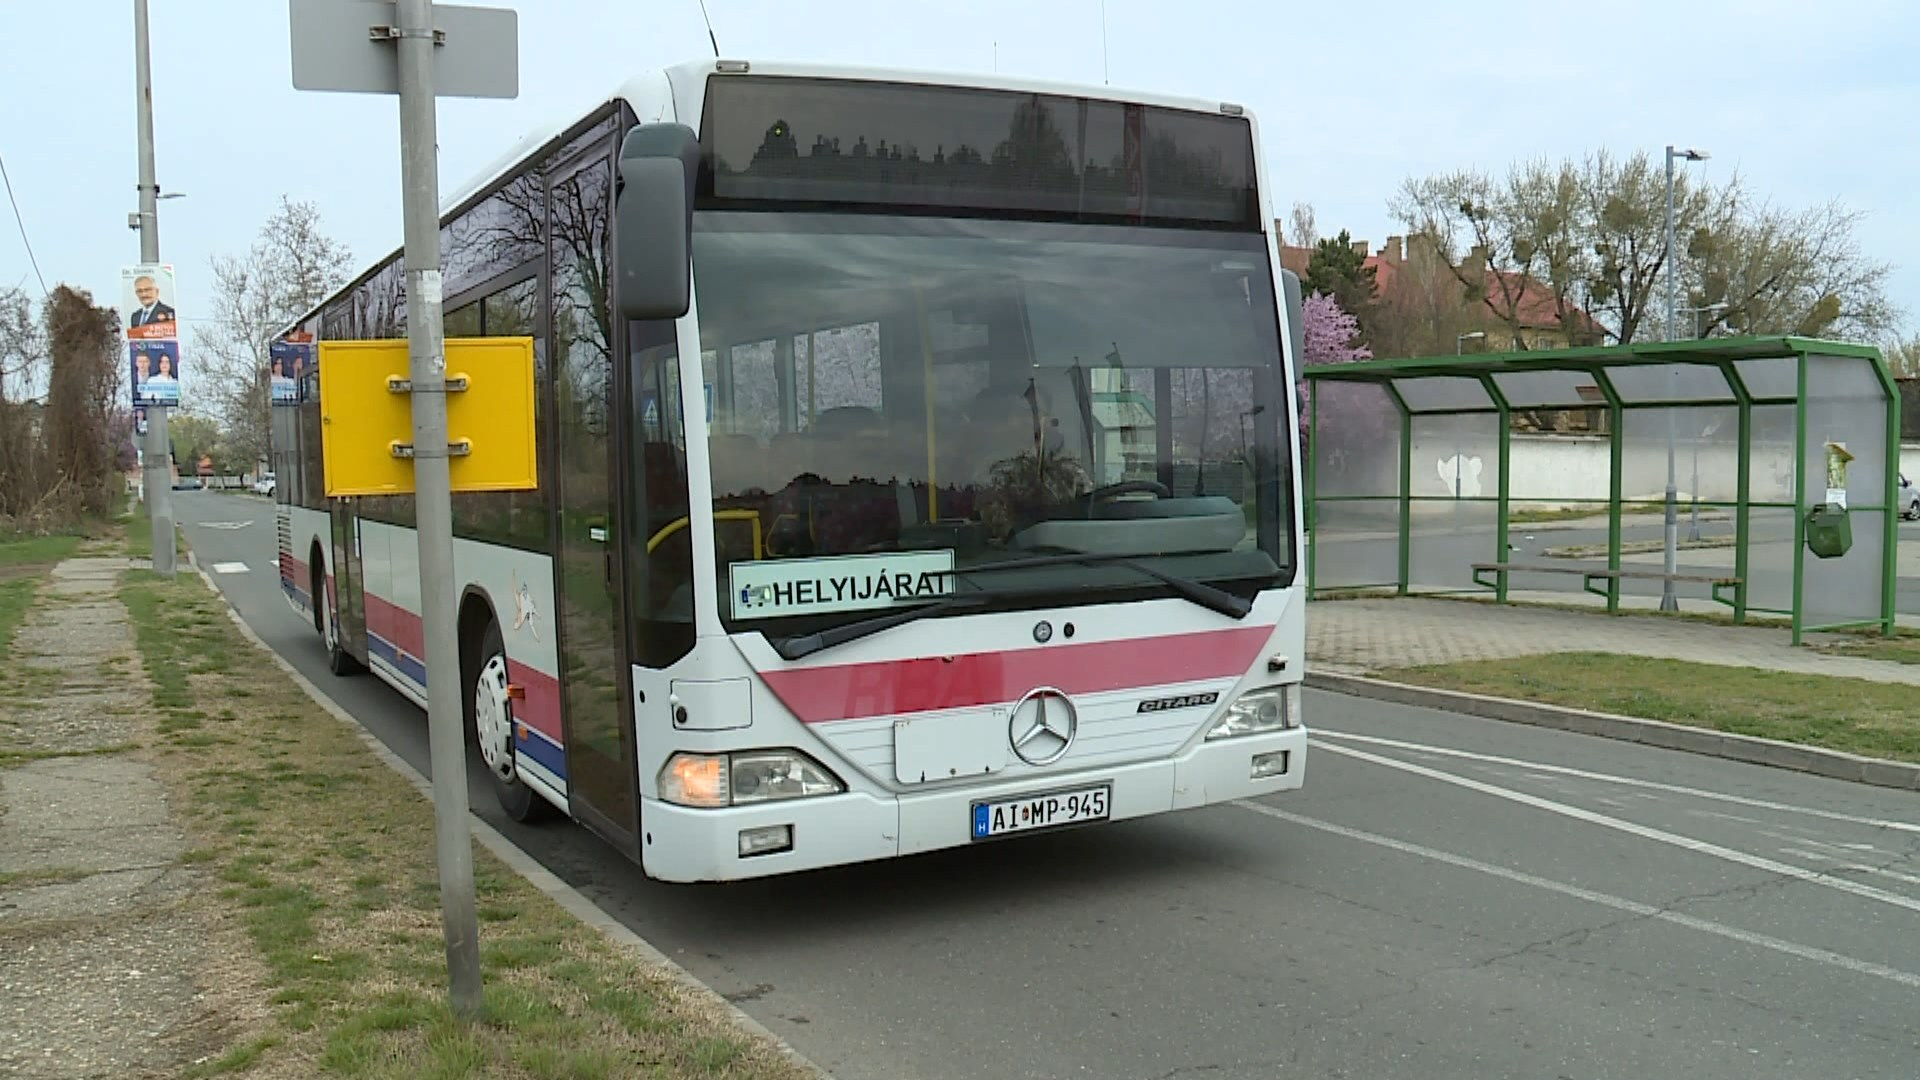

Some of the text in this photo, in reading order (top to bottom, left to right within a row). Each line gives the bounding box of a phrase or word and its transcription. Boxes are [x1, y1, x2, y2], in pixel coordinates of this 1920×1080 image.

[772, 568, 947, 606] HELYIJÁRAT
[1141, 693, 1216, 711] CITARO
[992, 792, 1104, 831] AI MP-945
